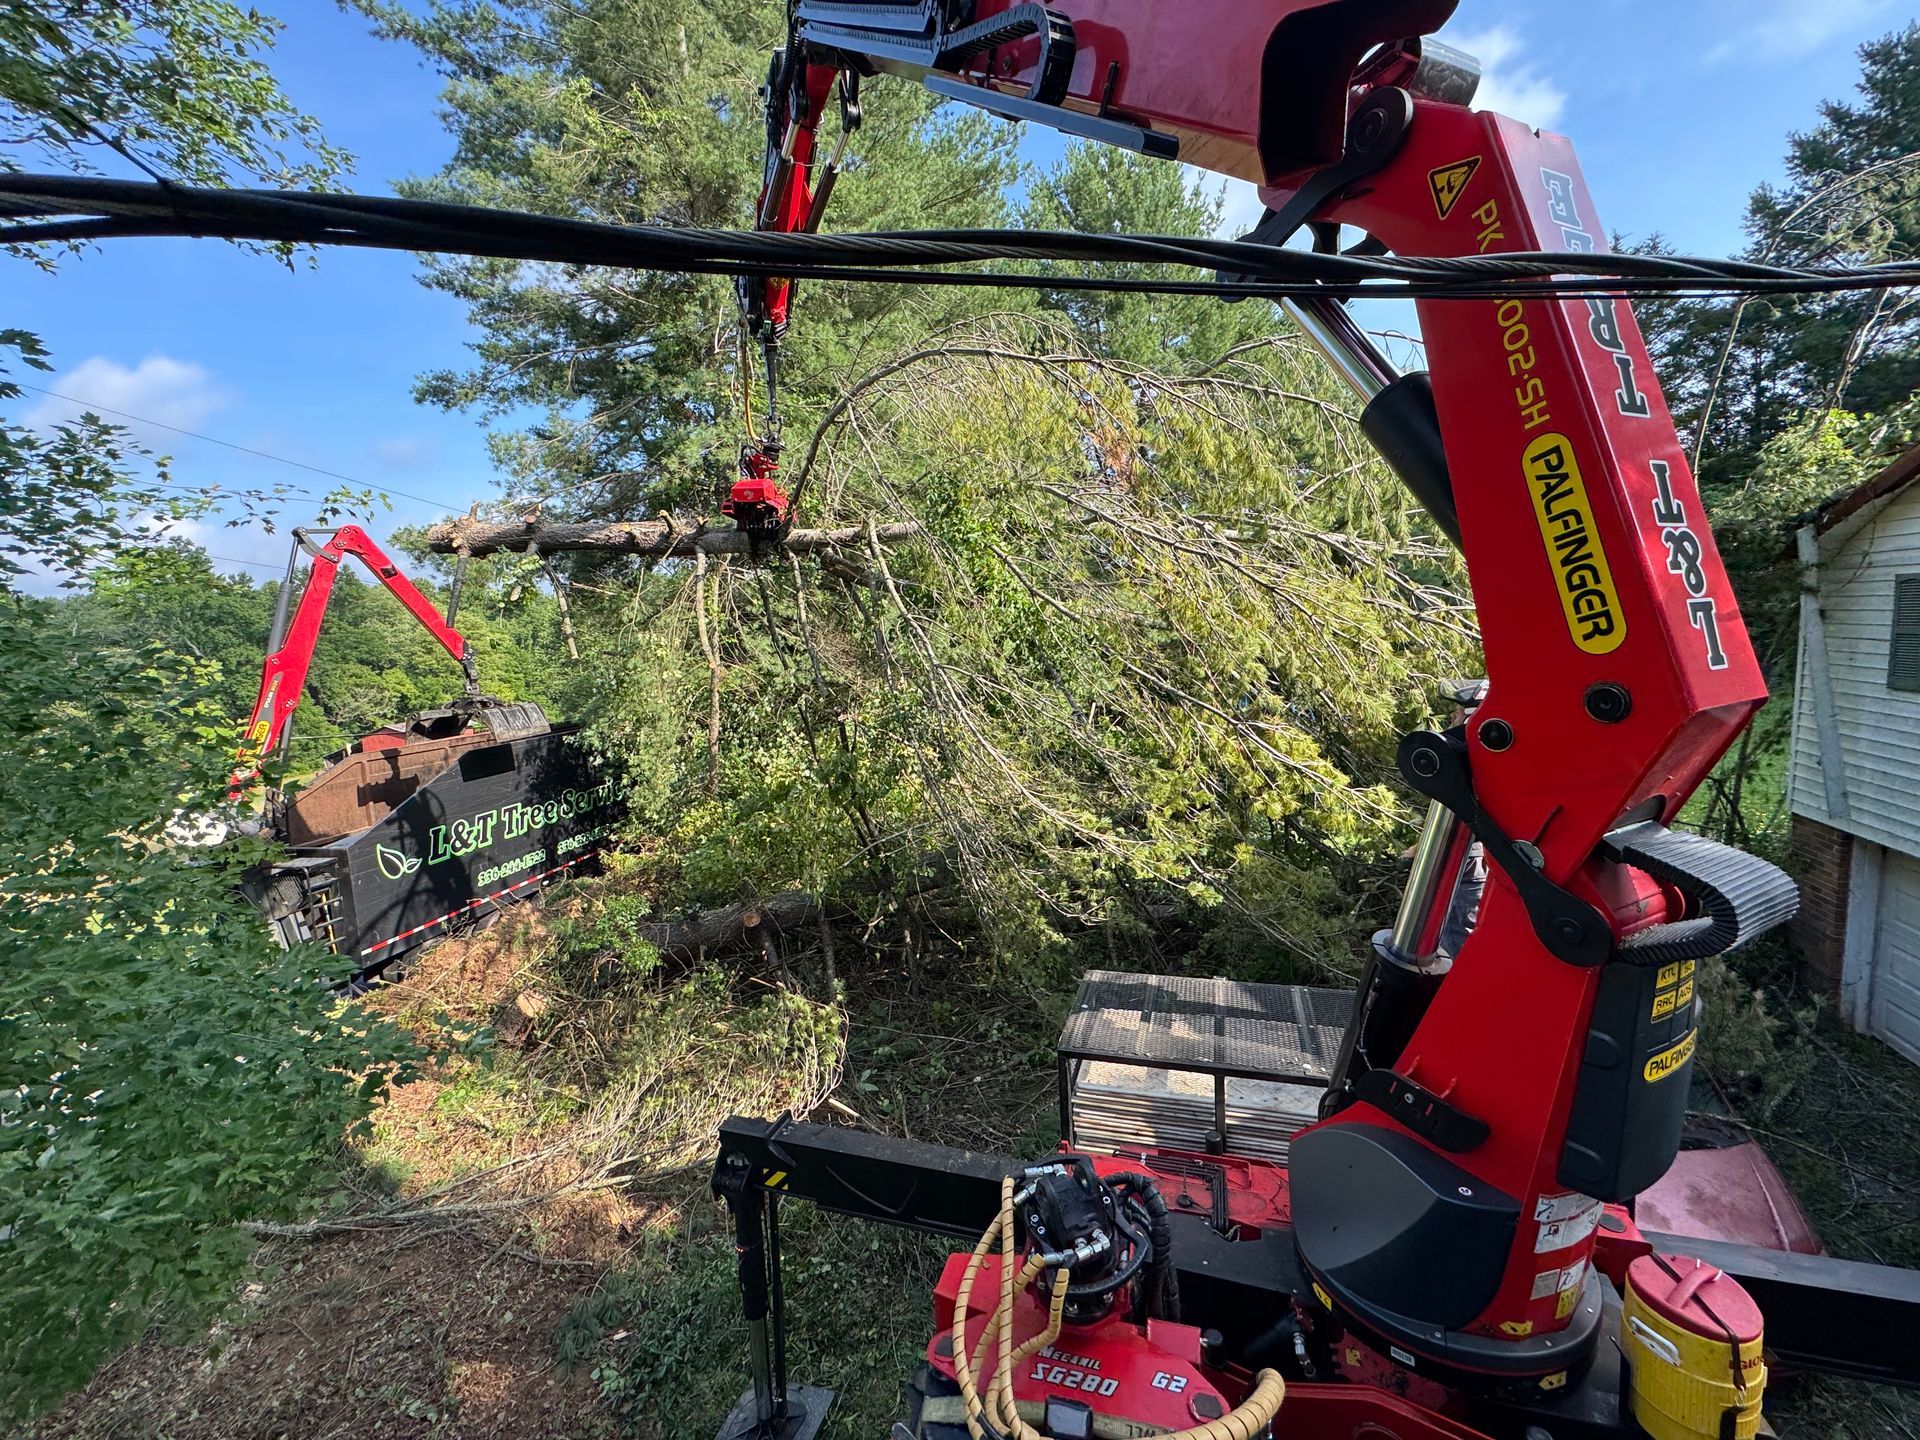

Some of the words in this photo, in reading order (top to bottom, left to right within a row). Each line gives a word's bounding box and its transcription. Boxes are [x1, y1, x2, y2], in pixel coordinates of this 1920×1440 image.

[1471, 198, 1504, 253] PK
[1529, 443, 1615, 642] PALFINGER
[428, 809, 497, 865] L&T
[501, 800, 558, 839] Tree
[560, 776, 628, 819] Servic
[1029, 1362, 1119, 1397] SG280
[1151, 1371, 1188, 1393] G2
